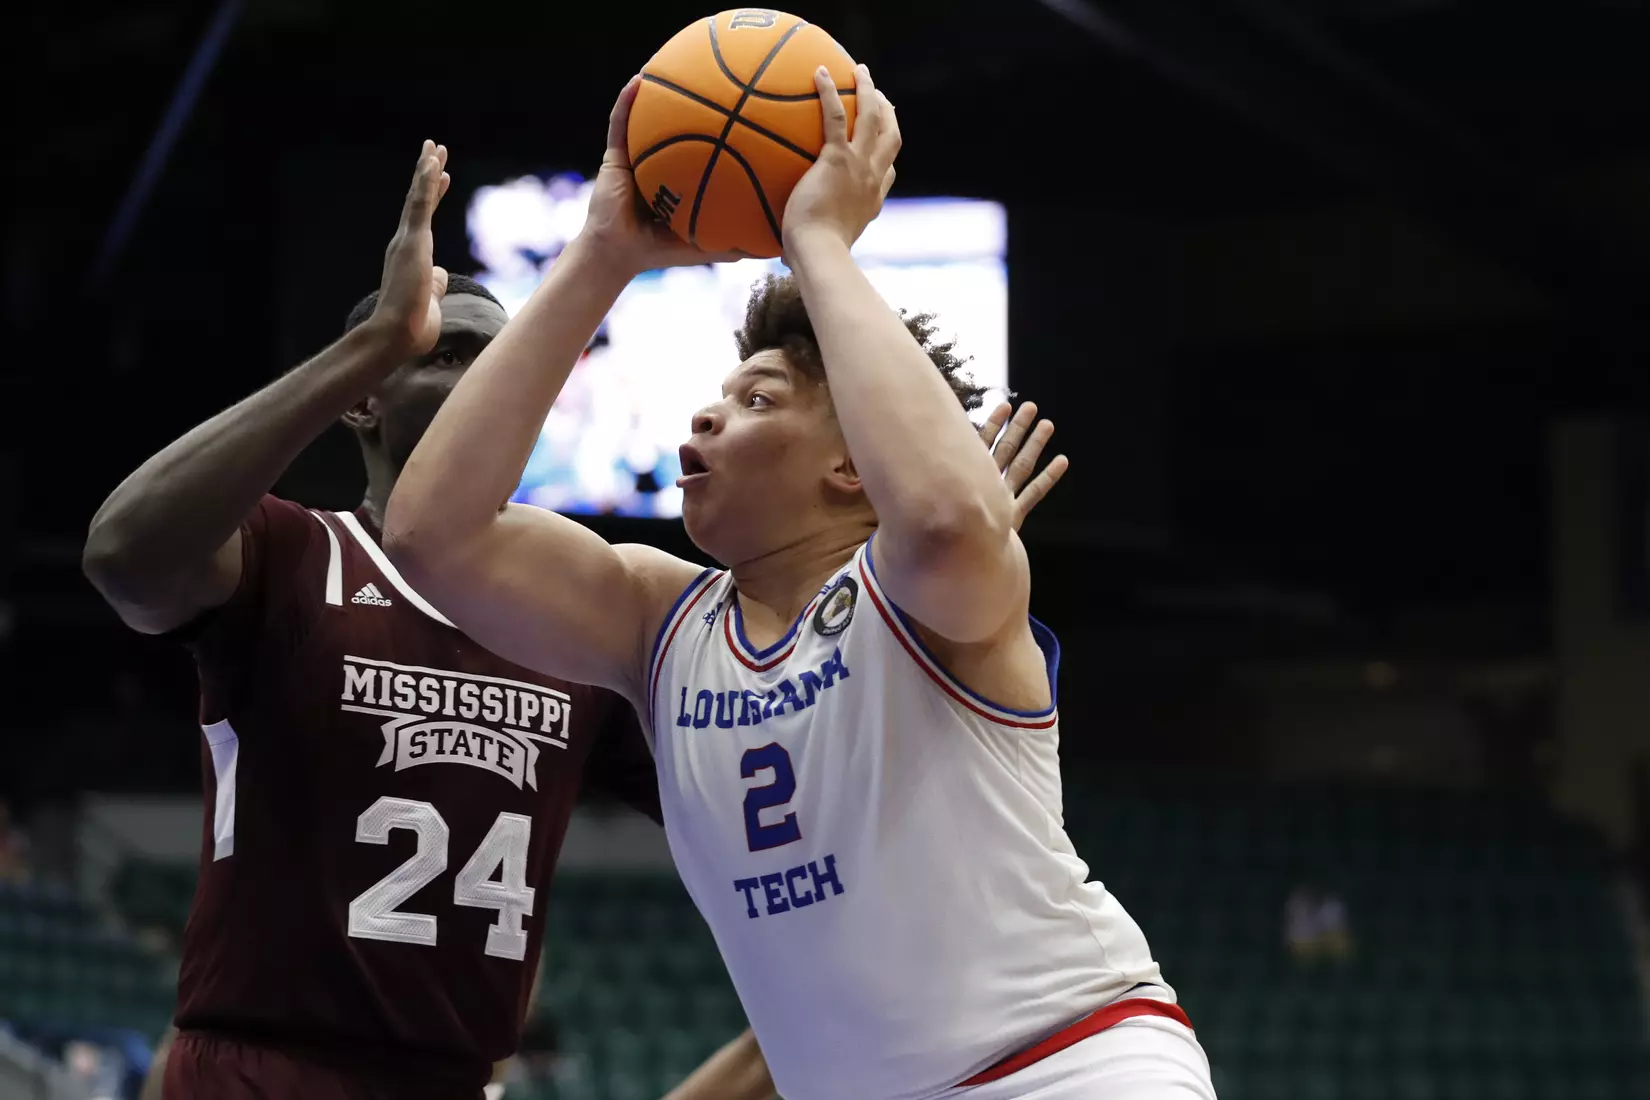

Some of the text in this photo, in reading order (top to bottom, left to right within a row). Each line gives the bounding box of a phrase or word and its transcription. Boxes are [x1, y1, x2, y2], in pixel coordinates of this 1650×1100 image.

[351, 596, 392, 607] adidas
[341, 664, 571, 740] MISSISSIPPI
[409, 728, 515, 775] STATE
[740, 741, 803, 853] 2
[347, 796, 536, 962] 24
[733, 854, 845, 919] TECH
